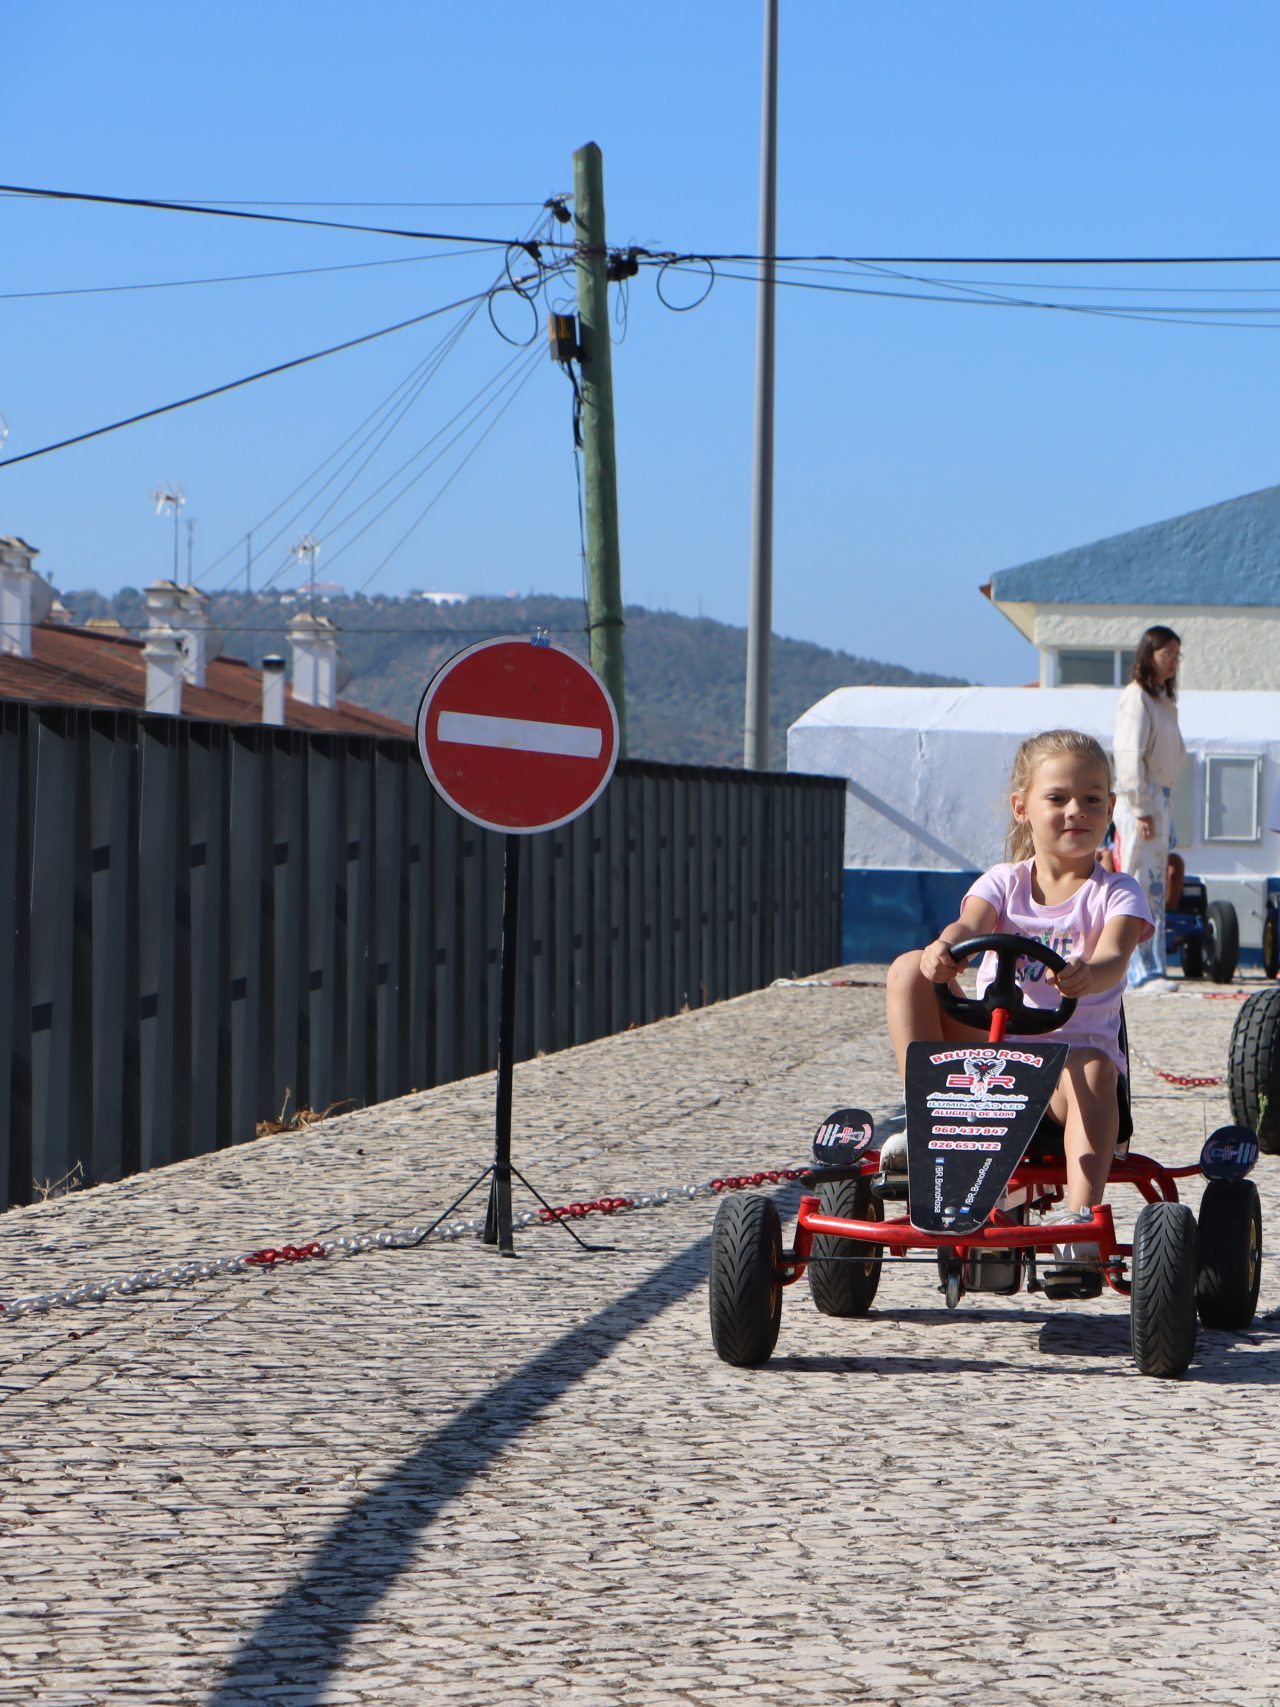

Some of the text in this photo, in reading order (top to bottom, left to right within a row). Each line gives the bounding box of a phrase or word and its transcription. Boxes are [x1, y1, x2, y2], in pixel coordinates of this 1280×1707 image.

[930, 1049, 1043, 1067] BRUNO ROSA
[927, 1101, 1000, 1110] ILUMINAÇÃO
[932, 1109, 977, 1117] ALUGUER
[933, 1126, 1007, 1136] 968 437 847
[929, 1141, 1001, 1150] 926 653 122
